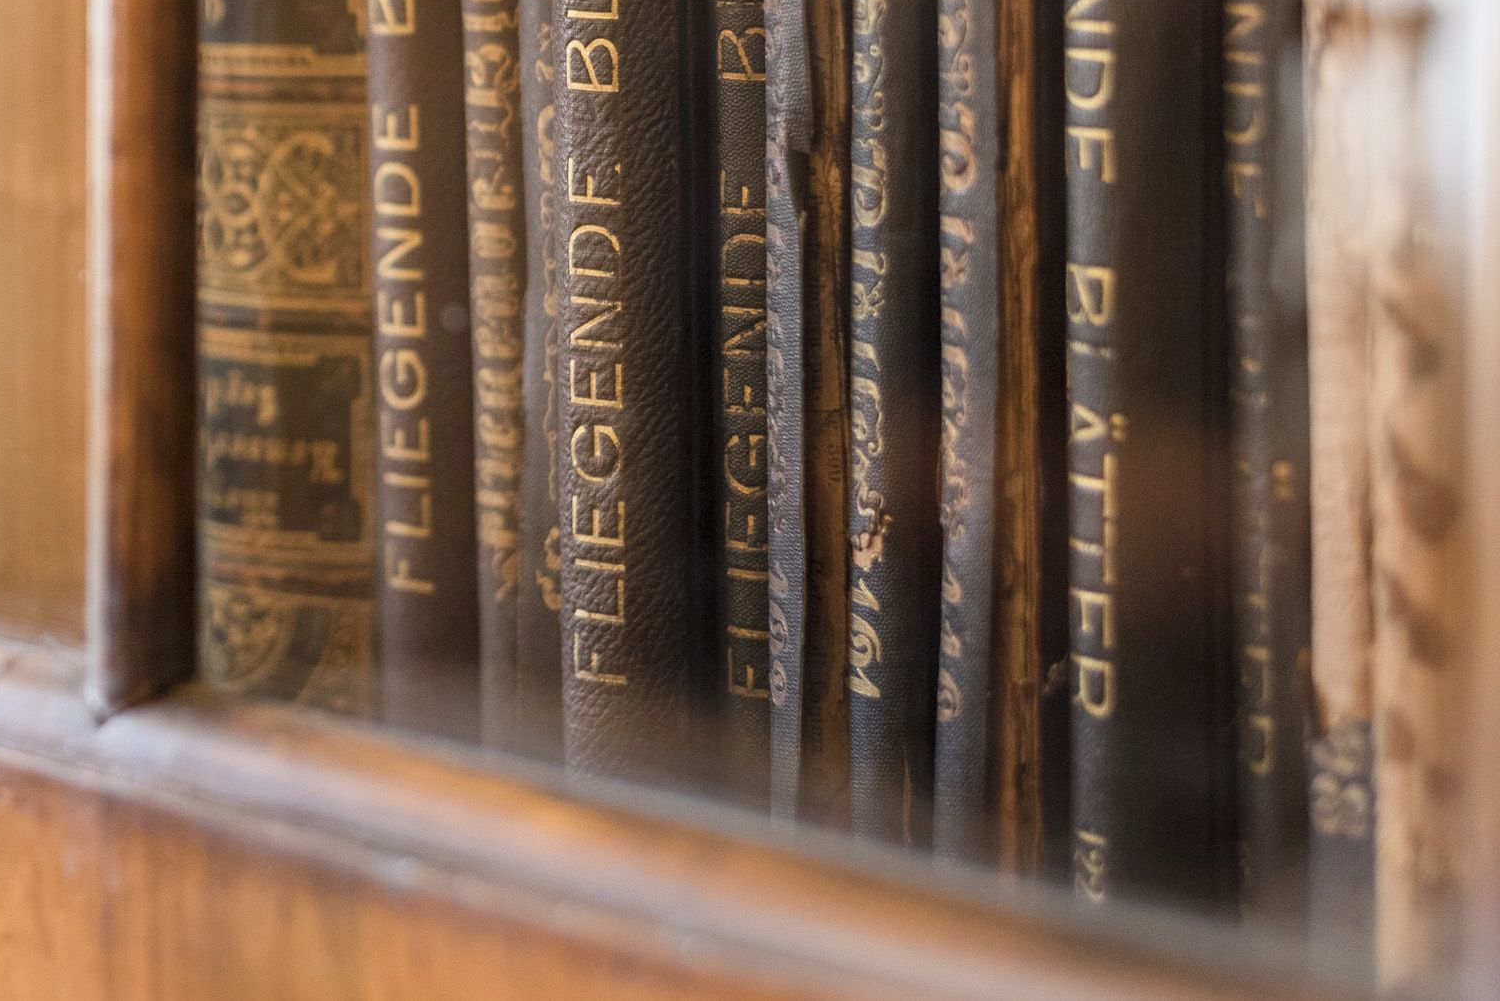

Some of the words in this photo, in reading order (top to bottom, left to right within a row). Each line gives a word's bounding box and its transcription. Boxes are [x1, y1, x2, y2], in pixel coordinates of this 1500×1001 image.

[372, 101, 435, 595] FLIEGENDE
[566, 158, 627, 686] FLIEGENDE
[1065, 263, 1128, 720] BLÄTTER
